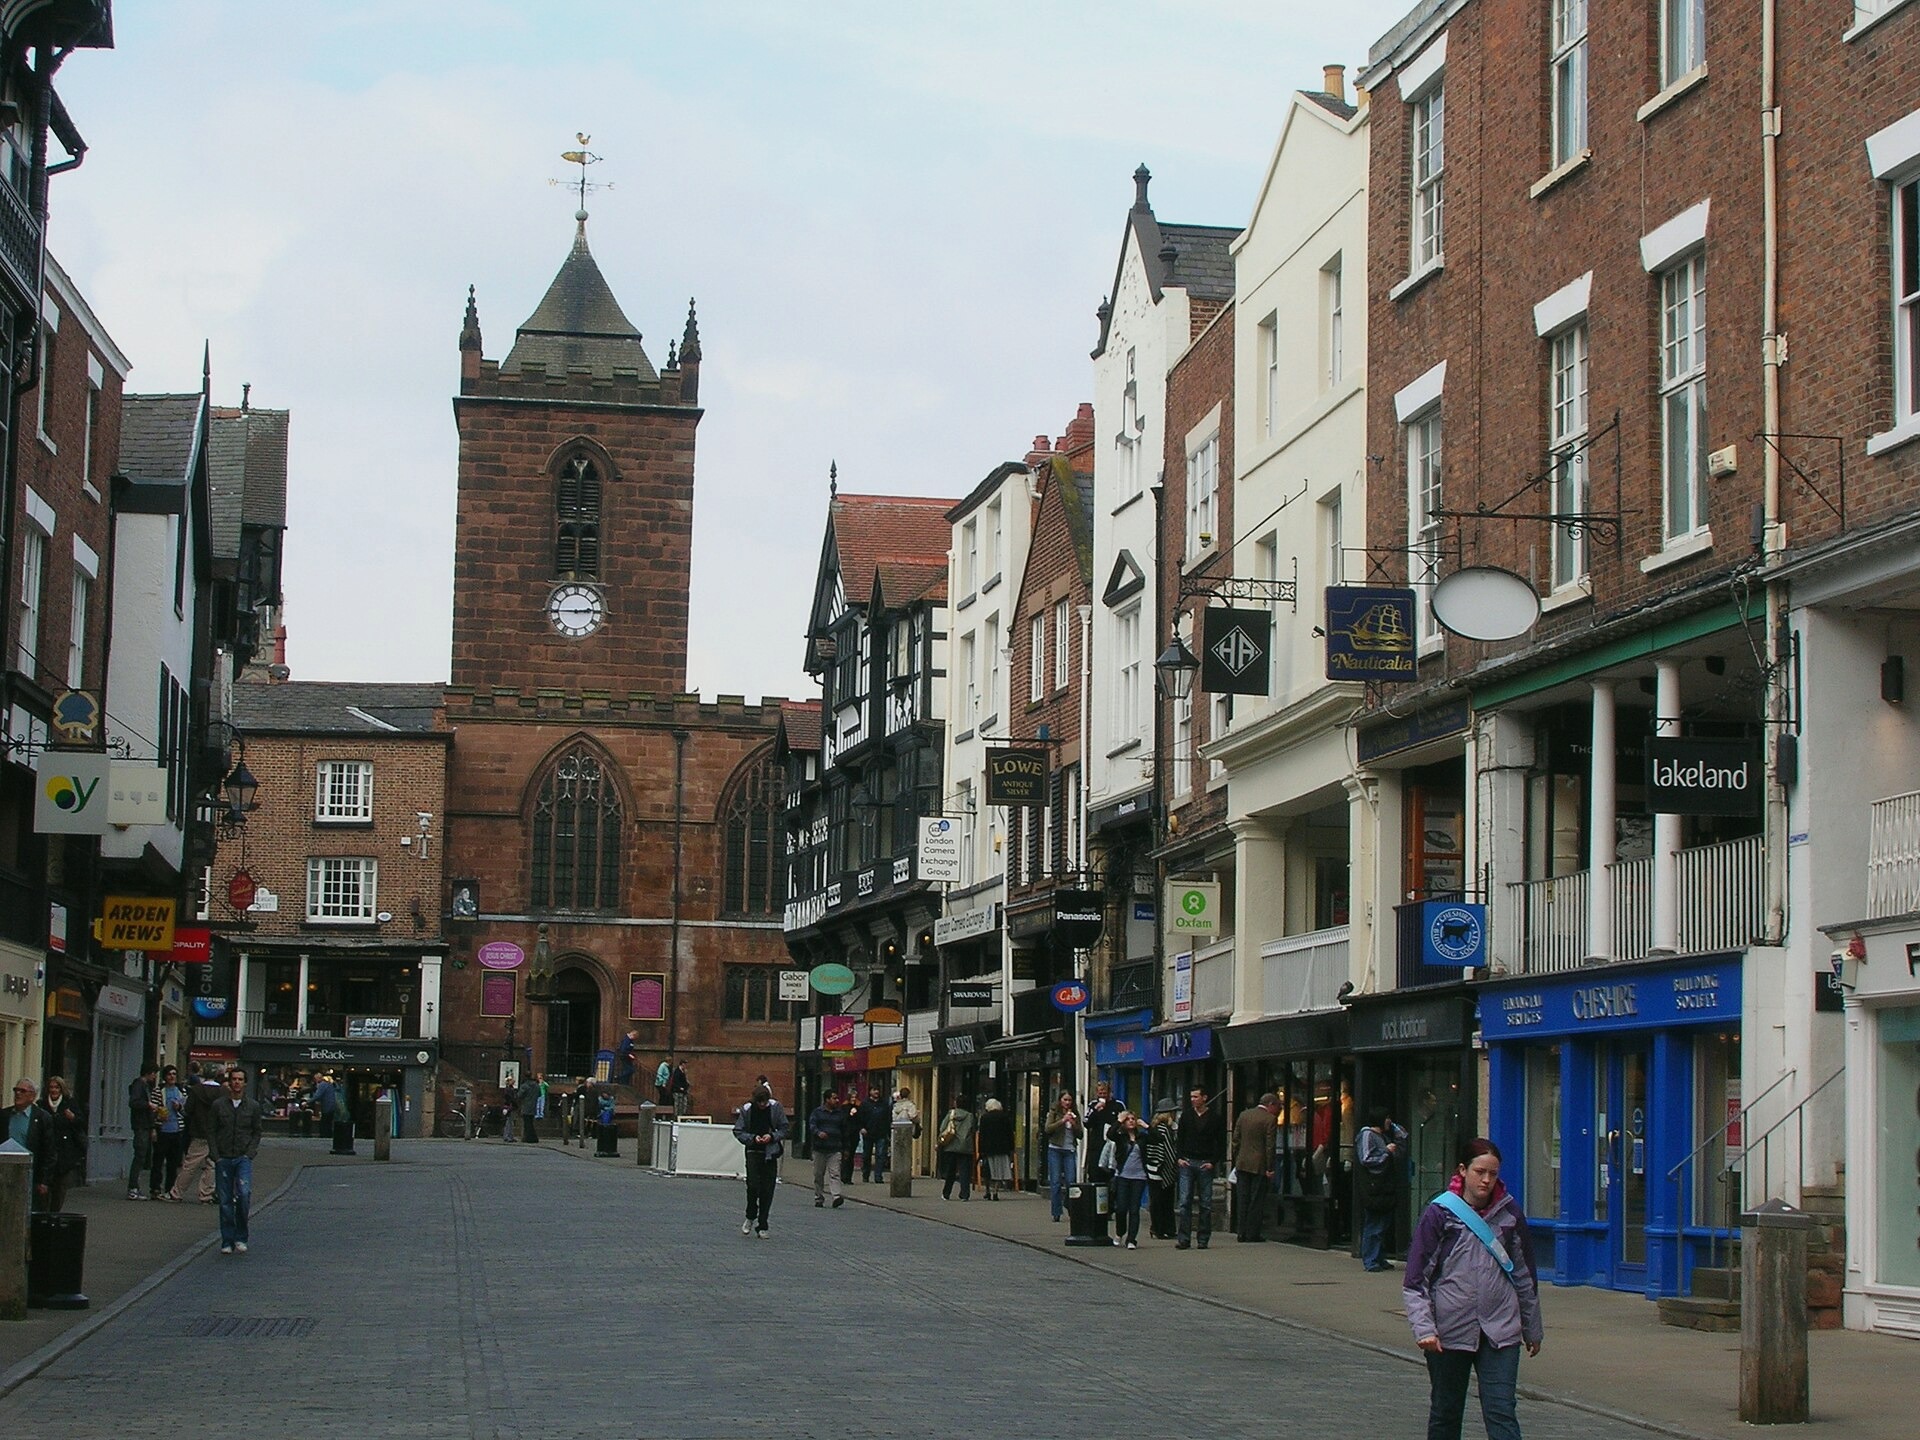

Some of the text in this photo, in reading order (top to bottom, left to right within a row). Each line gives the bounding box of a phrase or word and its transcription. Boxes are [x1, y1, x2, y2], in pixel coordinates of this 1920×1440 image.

[1331, 653, 1413, 671] Nauticalia
[992, 760, 1043, 776] LOWE
[1653, 758, 1747, 790] lakeland
[1002, 781, 1033, 789] ANTIQUE
[1006, 788, 1030, 796] SILVER
[925, 837, 954, 845] London
[923, 846, 956, 855] Camera
[920, 856, 959, 867] Exchange
[926, 867, 951, 877] Group
[109, 904, 170, 922] ARDEN
[1056, 911, 1102, 921] Panasonic
[1438, 911, 1472, 923] CHESHIRE
[1175, 917, 1212, 929] Oxfam
[112, 924, 165, 941] NEWS
[1433, 928, 1478, 957] BUILDING SOCIETY
[781, 972, 806, 982] Gabor
[1673, 974, 1719, 992] BUILDING
[1502, 994, 1542, 1010] FINANCIAL
[1572, 984, 1637, 1020] CHESHIRE
[1676, 993, 1717, 1010] SOCIETY
[365, 1018, 399, 1027] BRITISH
[1506, 1011, 1542, 1026] SERVICES
